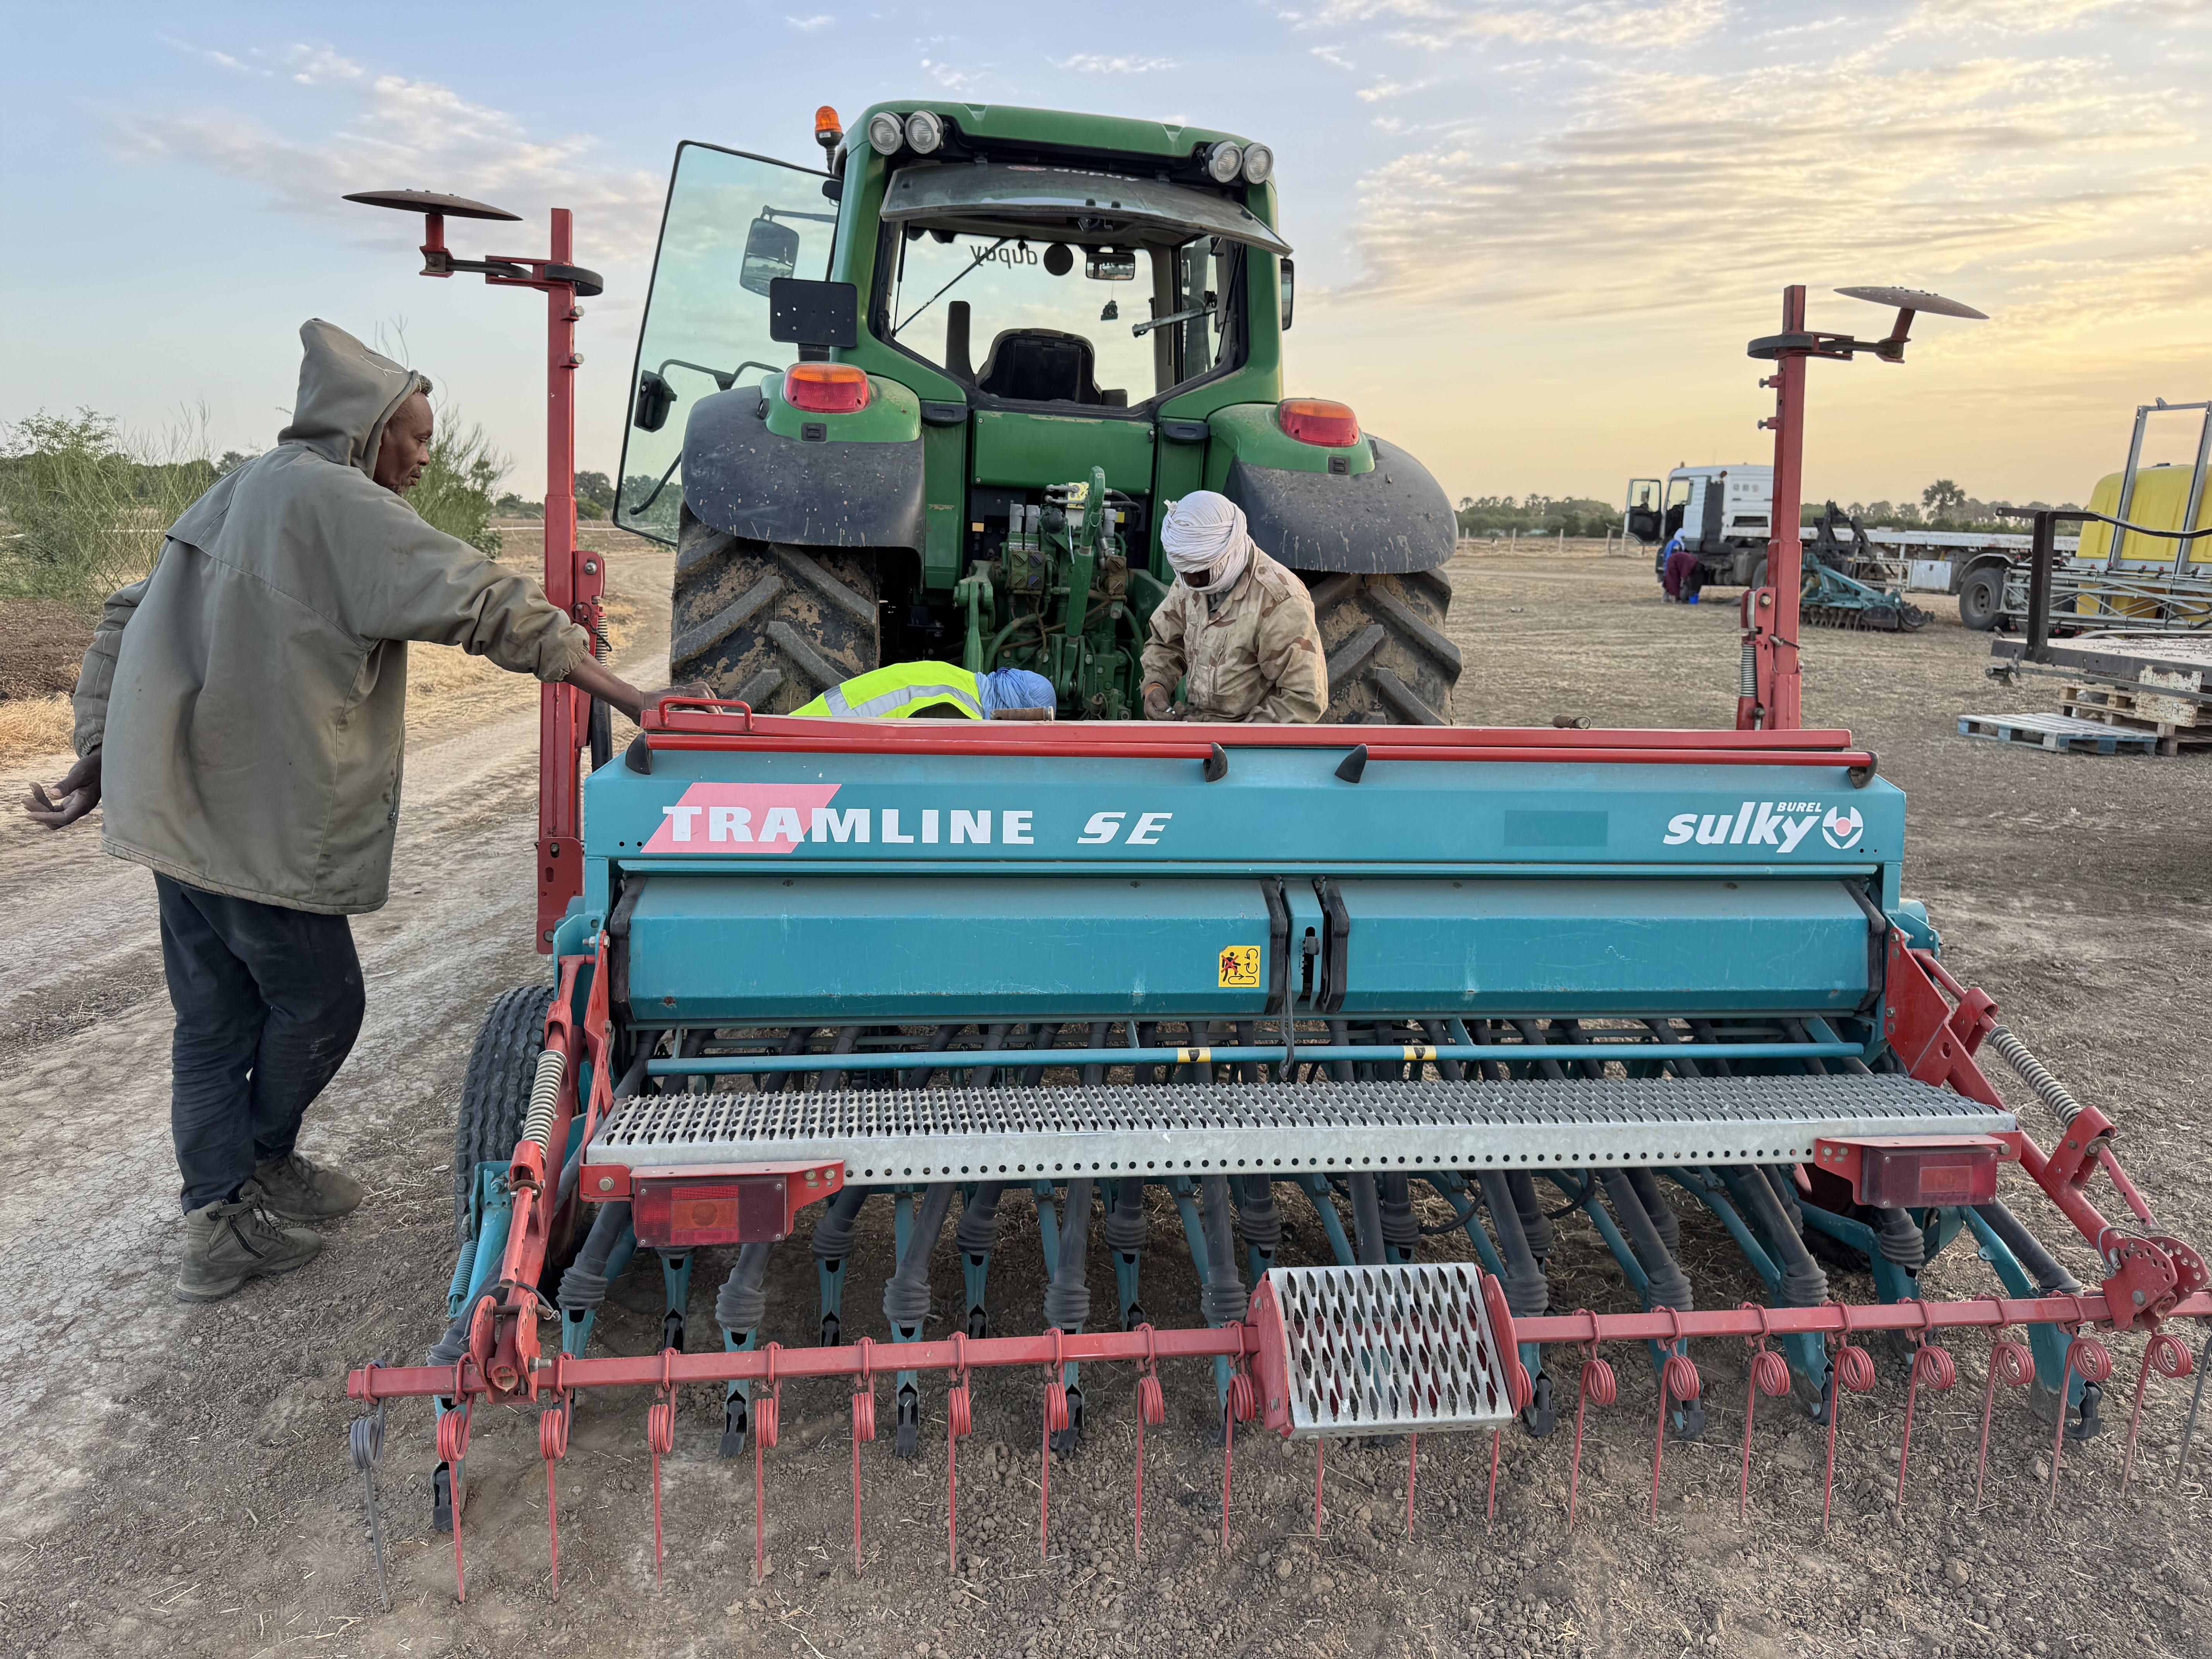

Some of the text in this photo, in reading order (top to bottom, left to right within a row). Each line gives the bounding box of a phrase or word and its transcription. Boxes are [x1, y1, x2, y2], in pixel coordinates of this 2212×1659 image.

[663, 806, 1173, 844] TRAMLINE SE
[1777, 802, 1822, 812] BUREL
[1663, 802, 1820, 853] sulky
